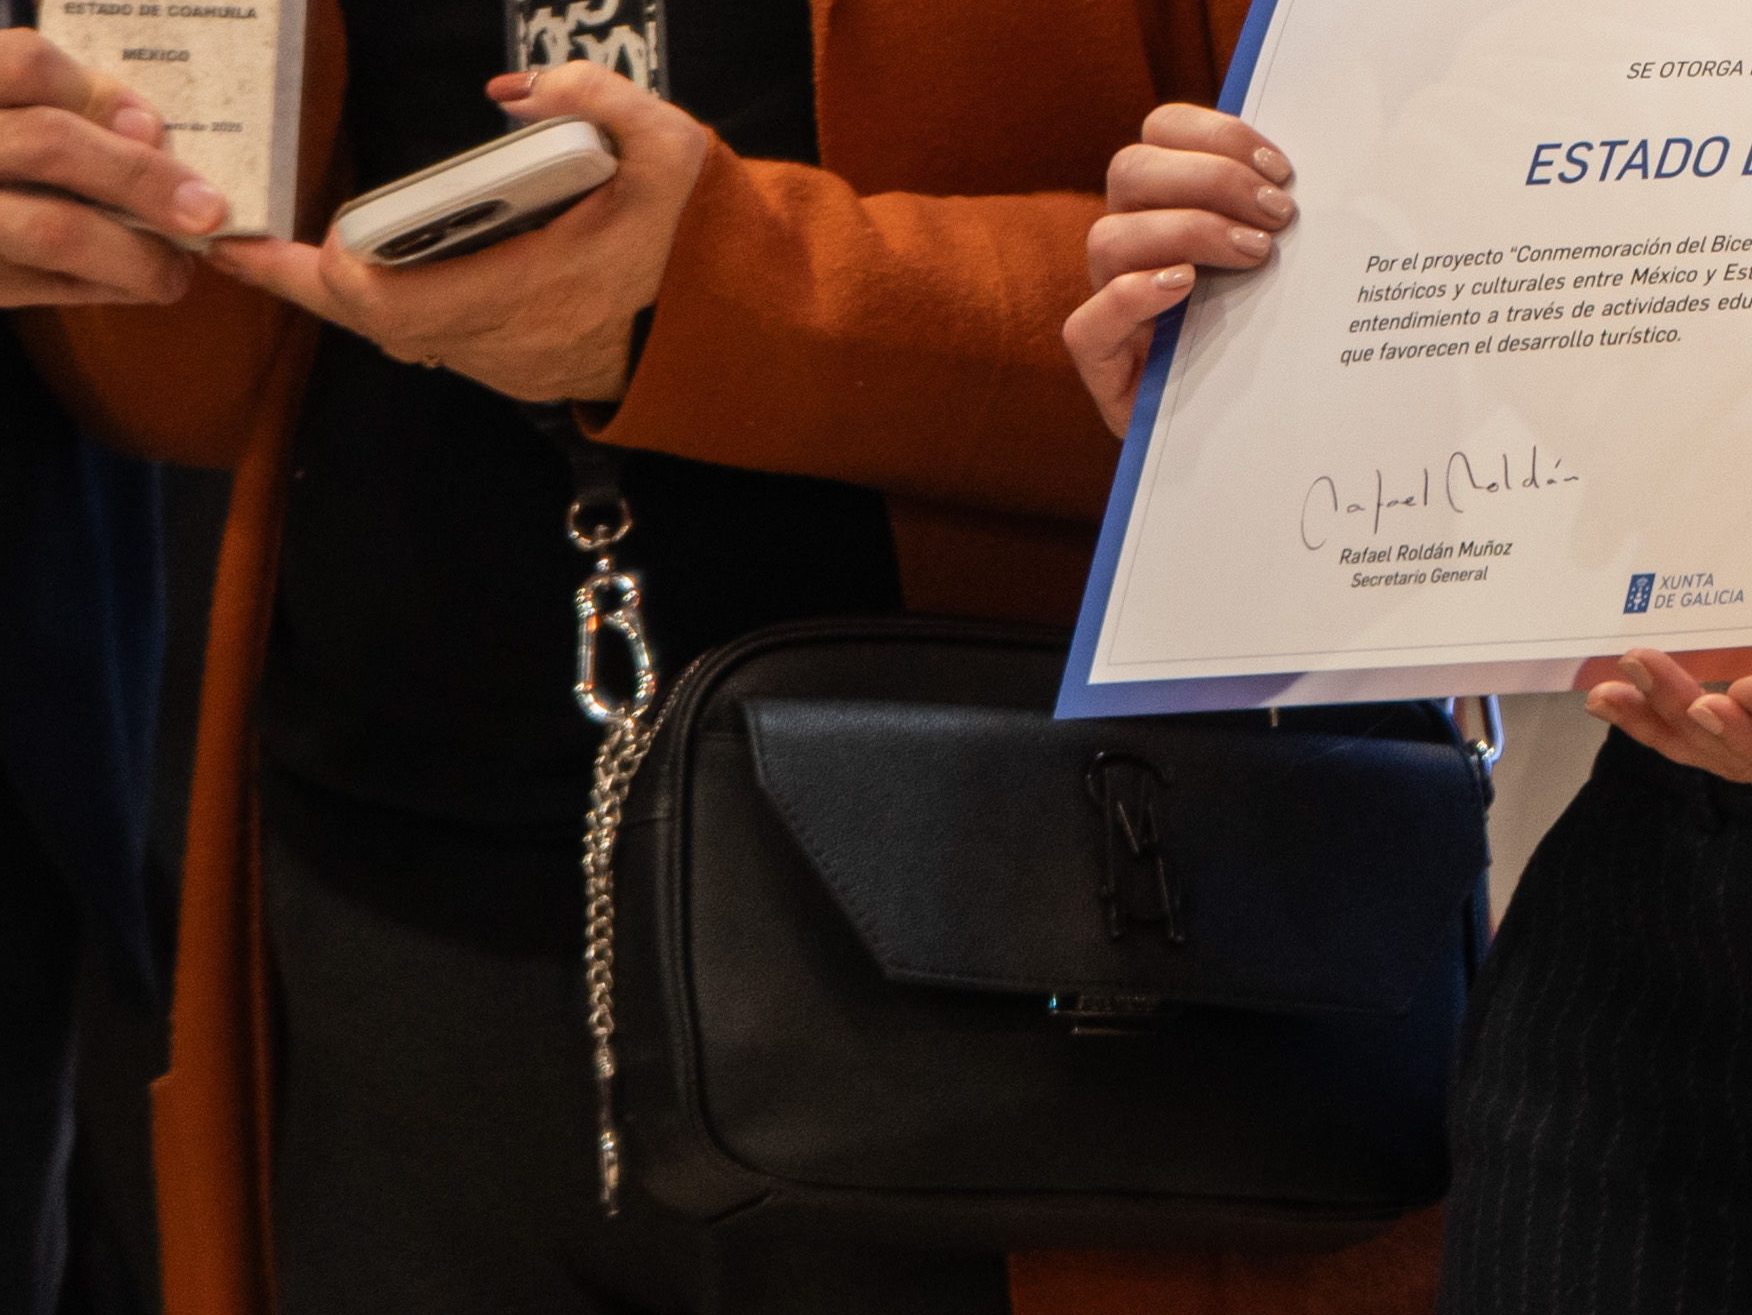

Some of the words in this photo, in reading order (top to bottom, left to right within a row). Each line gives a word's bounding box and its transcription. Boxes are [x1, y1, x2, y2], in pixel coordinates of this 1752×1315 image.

[64, 2, 133, 16] ESTADO
[139, 4, 160, 16] DE
[1626, 62, 1655, 79] SE
[1659, 60, 1744, 79] OTORGA
[1525, 135, 1731, 186] ESTADO
[1366, 255, 1399, 273] Por
[1401, 253, 1417, 271] el
[1421, 249, 1503, 273] proyecto
[1676, 236, 1707, 255] del
[1357, 281, 1447, 304] históricos
[1452, 283, 1465, 301] y
[1470, 275, 1566, 297] culturales
[1572, 272, 1624, 290] entre
[1630, 266, 1699, 286] México
[1703, 269, 1717, 286] y
[1349, 308, 1481, 334] entendimiento
[1487, 309, 1499, 326] a
[1506, 301, 1564, 323] través
[1570, 300, 1596, 319] de
[1601, 295, 1710, 317] actividades
[1339, 345, 1374, 367] que
[1378, 338, 1470, 362] favorecen
[1474, 335, 1492, 355] el
[1496, 329, 1594, 354] desarrollo
[1599, 324, 1682, 347] turístico.
[1340, 545, 1392, 566] Rafael
[1396, 541, 1454, 562] Roldán
[1458, 539, 1514, 558] Muñoz
[1350, 569, 1427, 589] Secretario
[1430, 566, 1489, 584] General
[1658, 573, 1715, 591] XUNTA
[1654, 592, 1676, 610] DE
[1679, 589, 1745, 609] GALICIA
